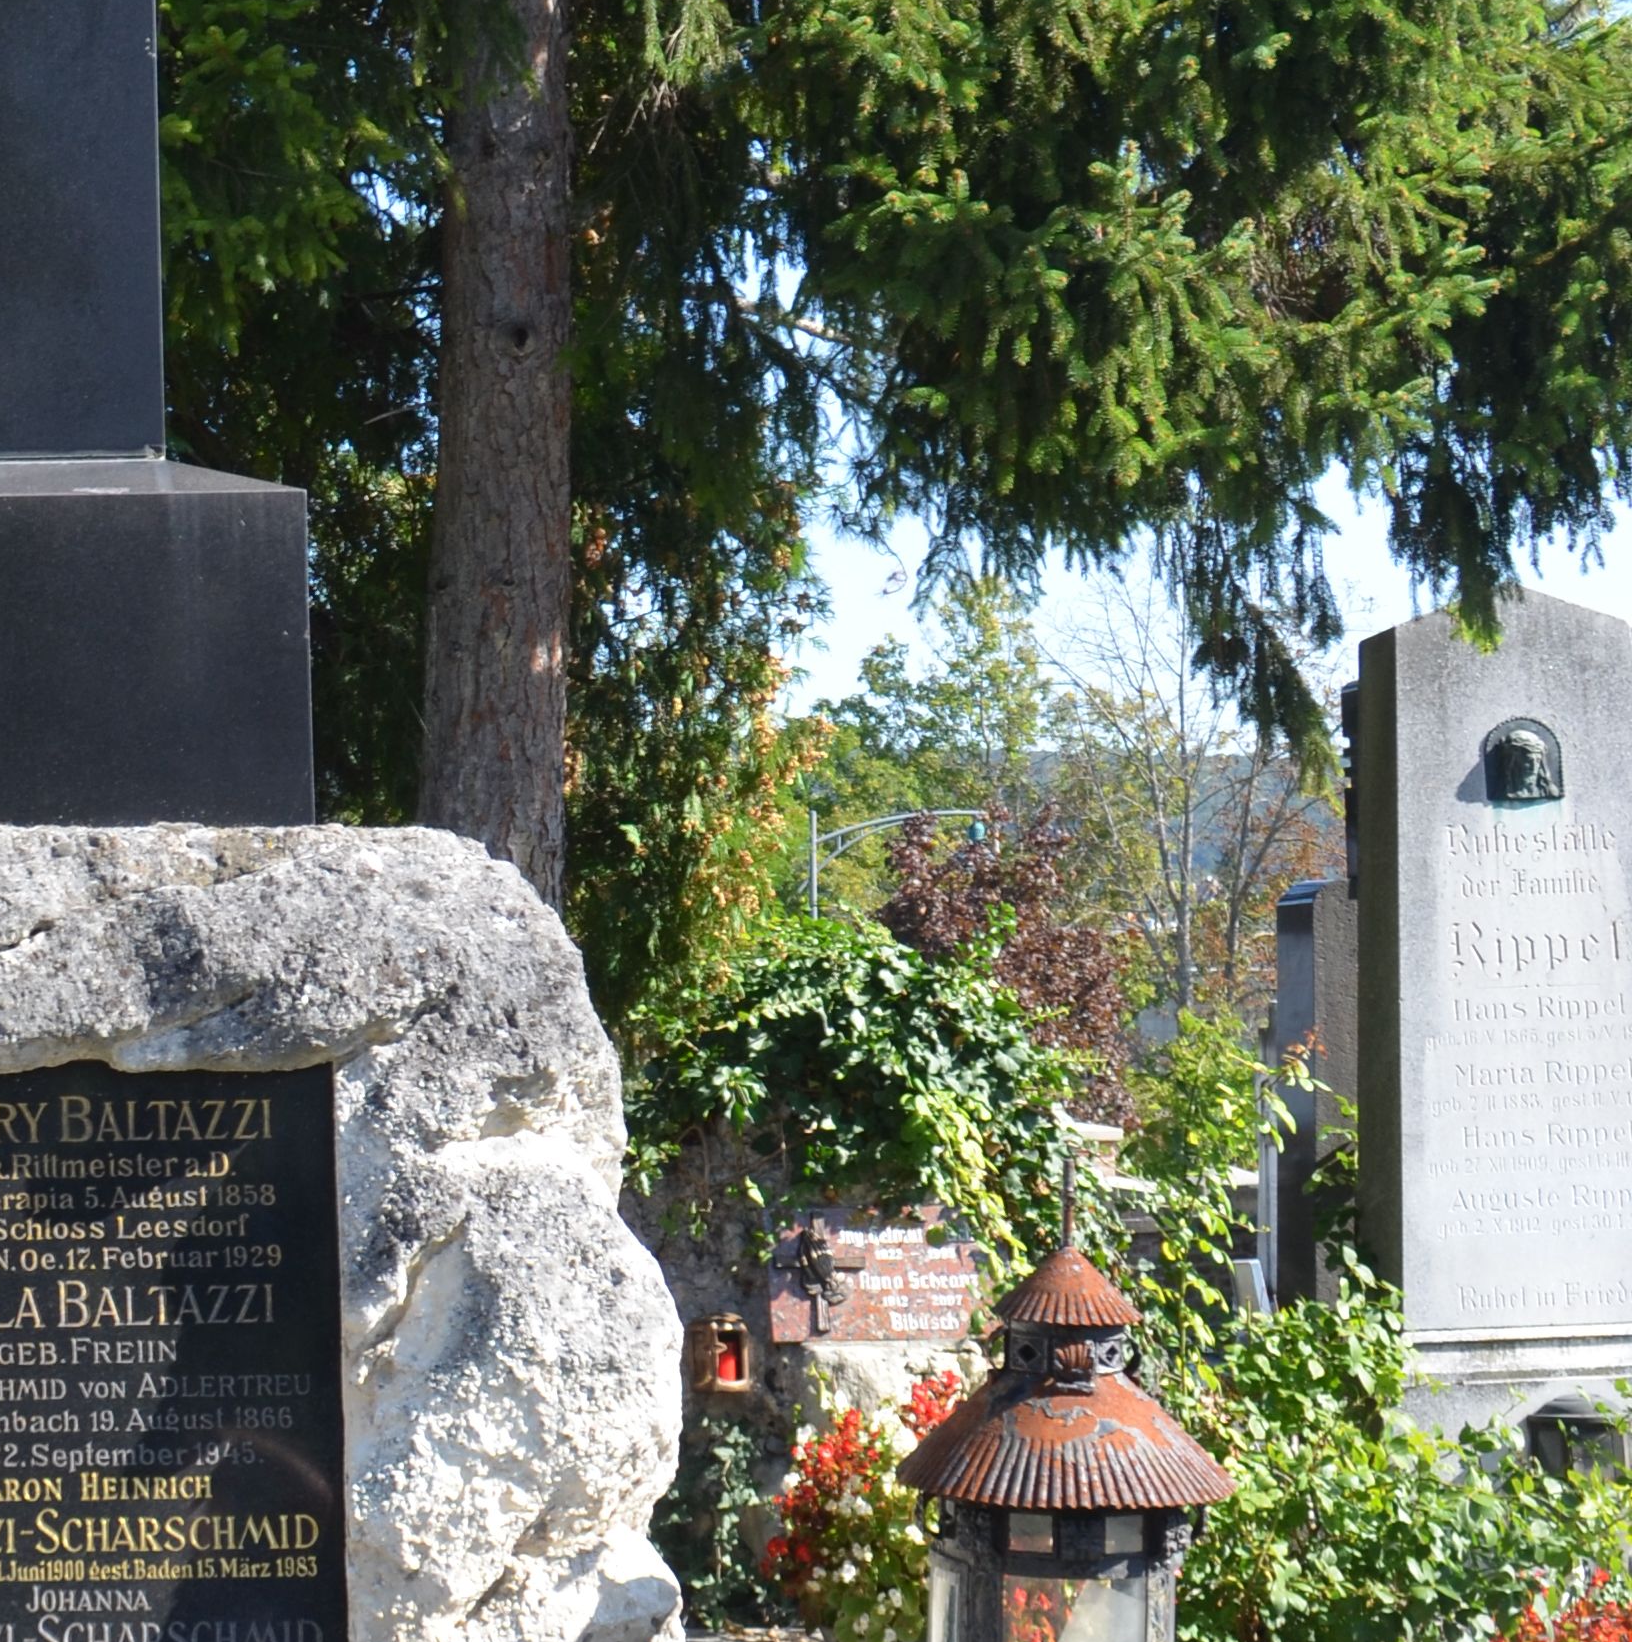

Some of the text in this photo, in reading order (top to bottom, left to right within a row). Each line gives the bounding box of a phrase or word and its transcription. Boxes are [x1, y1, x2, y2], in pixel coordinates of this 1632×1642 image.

[1449, 919, 1621, 978] Rippel
[1454, 992, 1628, 1022] Hans Rippel
[1455, 1061, 1536, 1087] Maria
[58, 1095, 273, 1144] BALTAZZI
[1463, 1125, 1536, 1149] Hans
[109, 1185, 208, 1211] August
[216, 1183, 276, 1207] 1858
[1449, 1187, 1560, 1213] Auguste
[115, 1213, 251, 1241] Leesdorf
[101, 1245, 219, 1271] Februar
[222, 1243, 283, 1269] 1929
[858, 1270, 905, 1291] Anna
[57, 1279, 276, 1330] BALTAZZI
[136, 1371, 312, 1401] ADLERTREU
[90, 1409, 121, 1434] 19.
[125, 1406, 224, 1434] August
[234, 1405, 294, 1431] 1866
[29, 1441, 188, 1474] September
[79, 1470, 214, 1502] HEINRICH
[220, 1555, 272, 1579] März
[274, 1554, 319, 1578] 1983
[25, 1583, 152, 1614] JOHANNA
